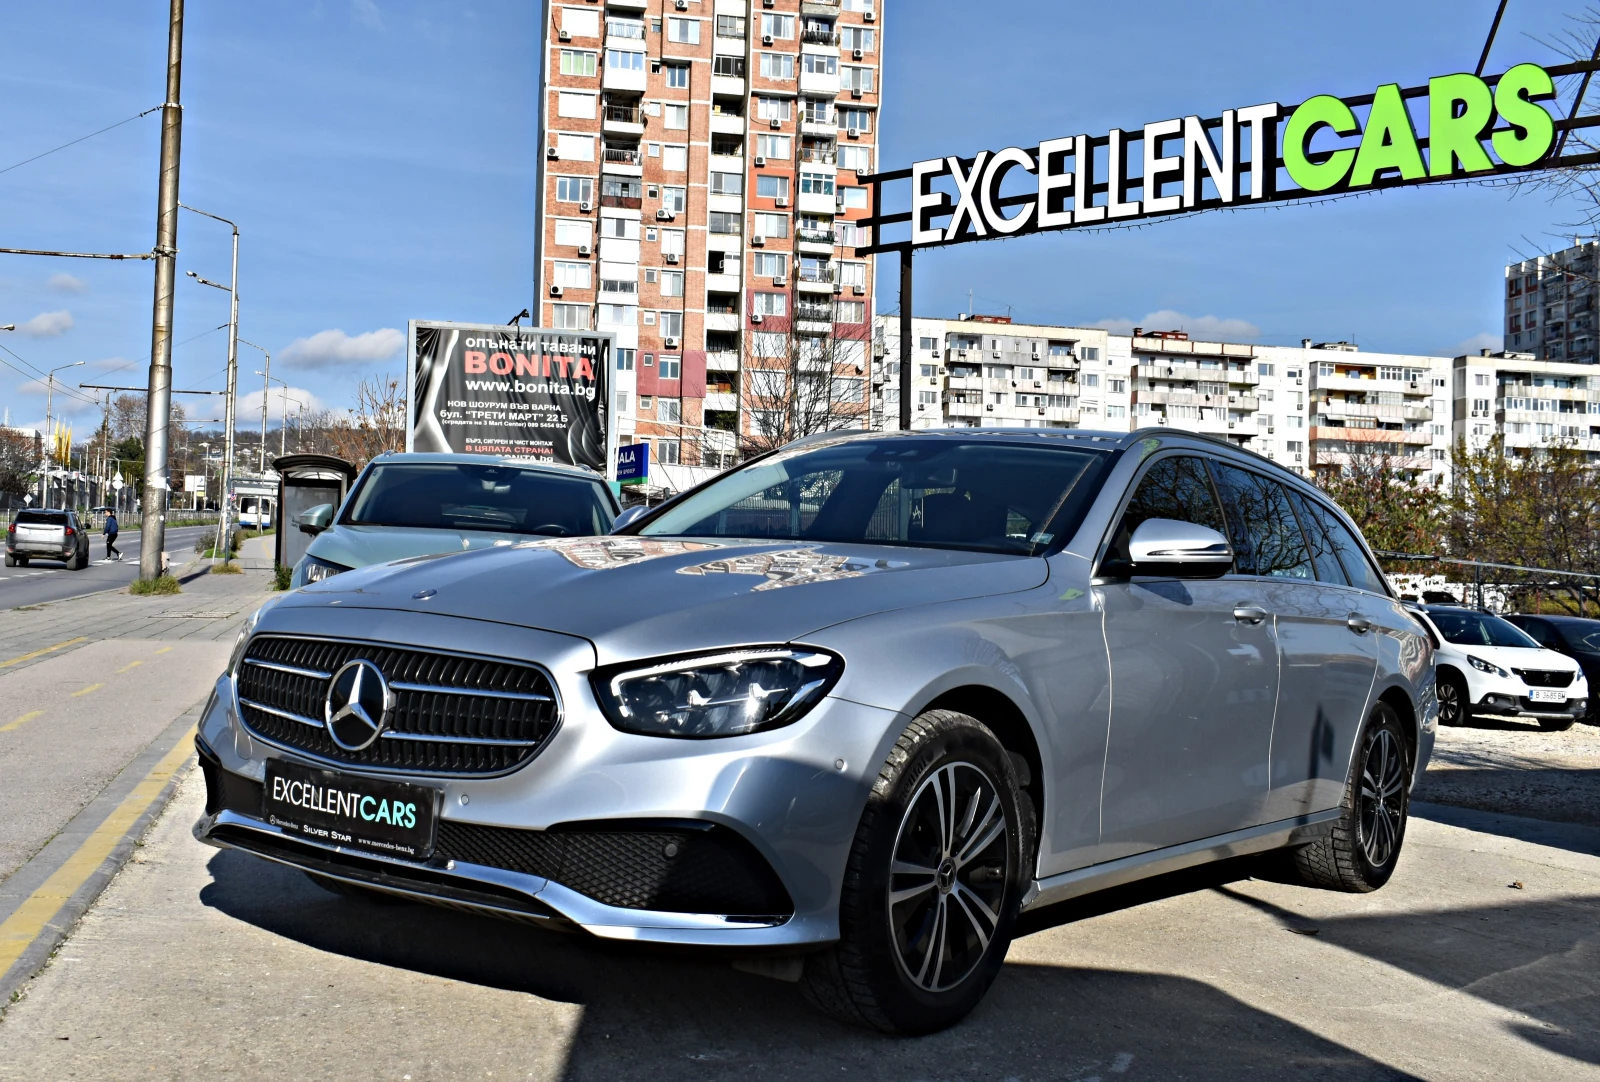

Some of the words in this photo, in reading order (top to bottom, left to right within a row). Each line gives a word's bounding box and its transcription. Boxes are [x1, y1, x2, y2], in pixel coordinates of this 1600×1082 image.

[912, 101, 1280, 245] EXCELLENT
[1281, 63, 1558, 192] CARS
[465, 337, 536, 351] опънати
[541, 341, 596, 355] тавани
[464, 350, 595, 381] BONITA
[465, 380, 596, 402] www.bonita.bg
[447, 400, 467, 408] НОВ
[469, 401, 508, 409] ШОУРУМ
[510, 402, 530, 410] ВЪВ
[532, 403, 562, 412] ВАРНА
[440, 409, 463, 420] бул.
[546, 413, 559, 422] 22
[560, 414, 569, 423] Б
[503, 420, 527, 428] Center)
[465, 444, 473, 452] В
[474, 445, 512, 453] ЦЯЛАТА
[514, 446, 554, 454] СТРАНА!
[273, 776, 361, 819] EXCELLENT
[359, 795, 416, 829] CARS
[303, 824, 329, 838] SILVER
[330, 830, 352, 843] STAR
